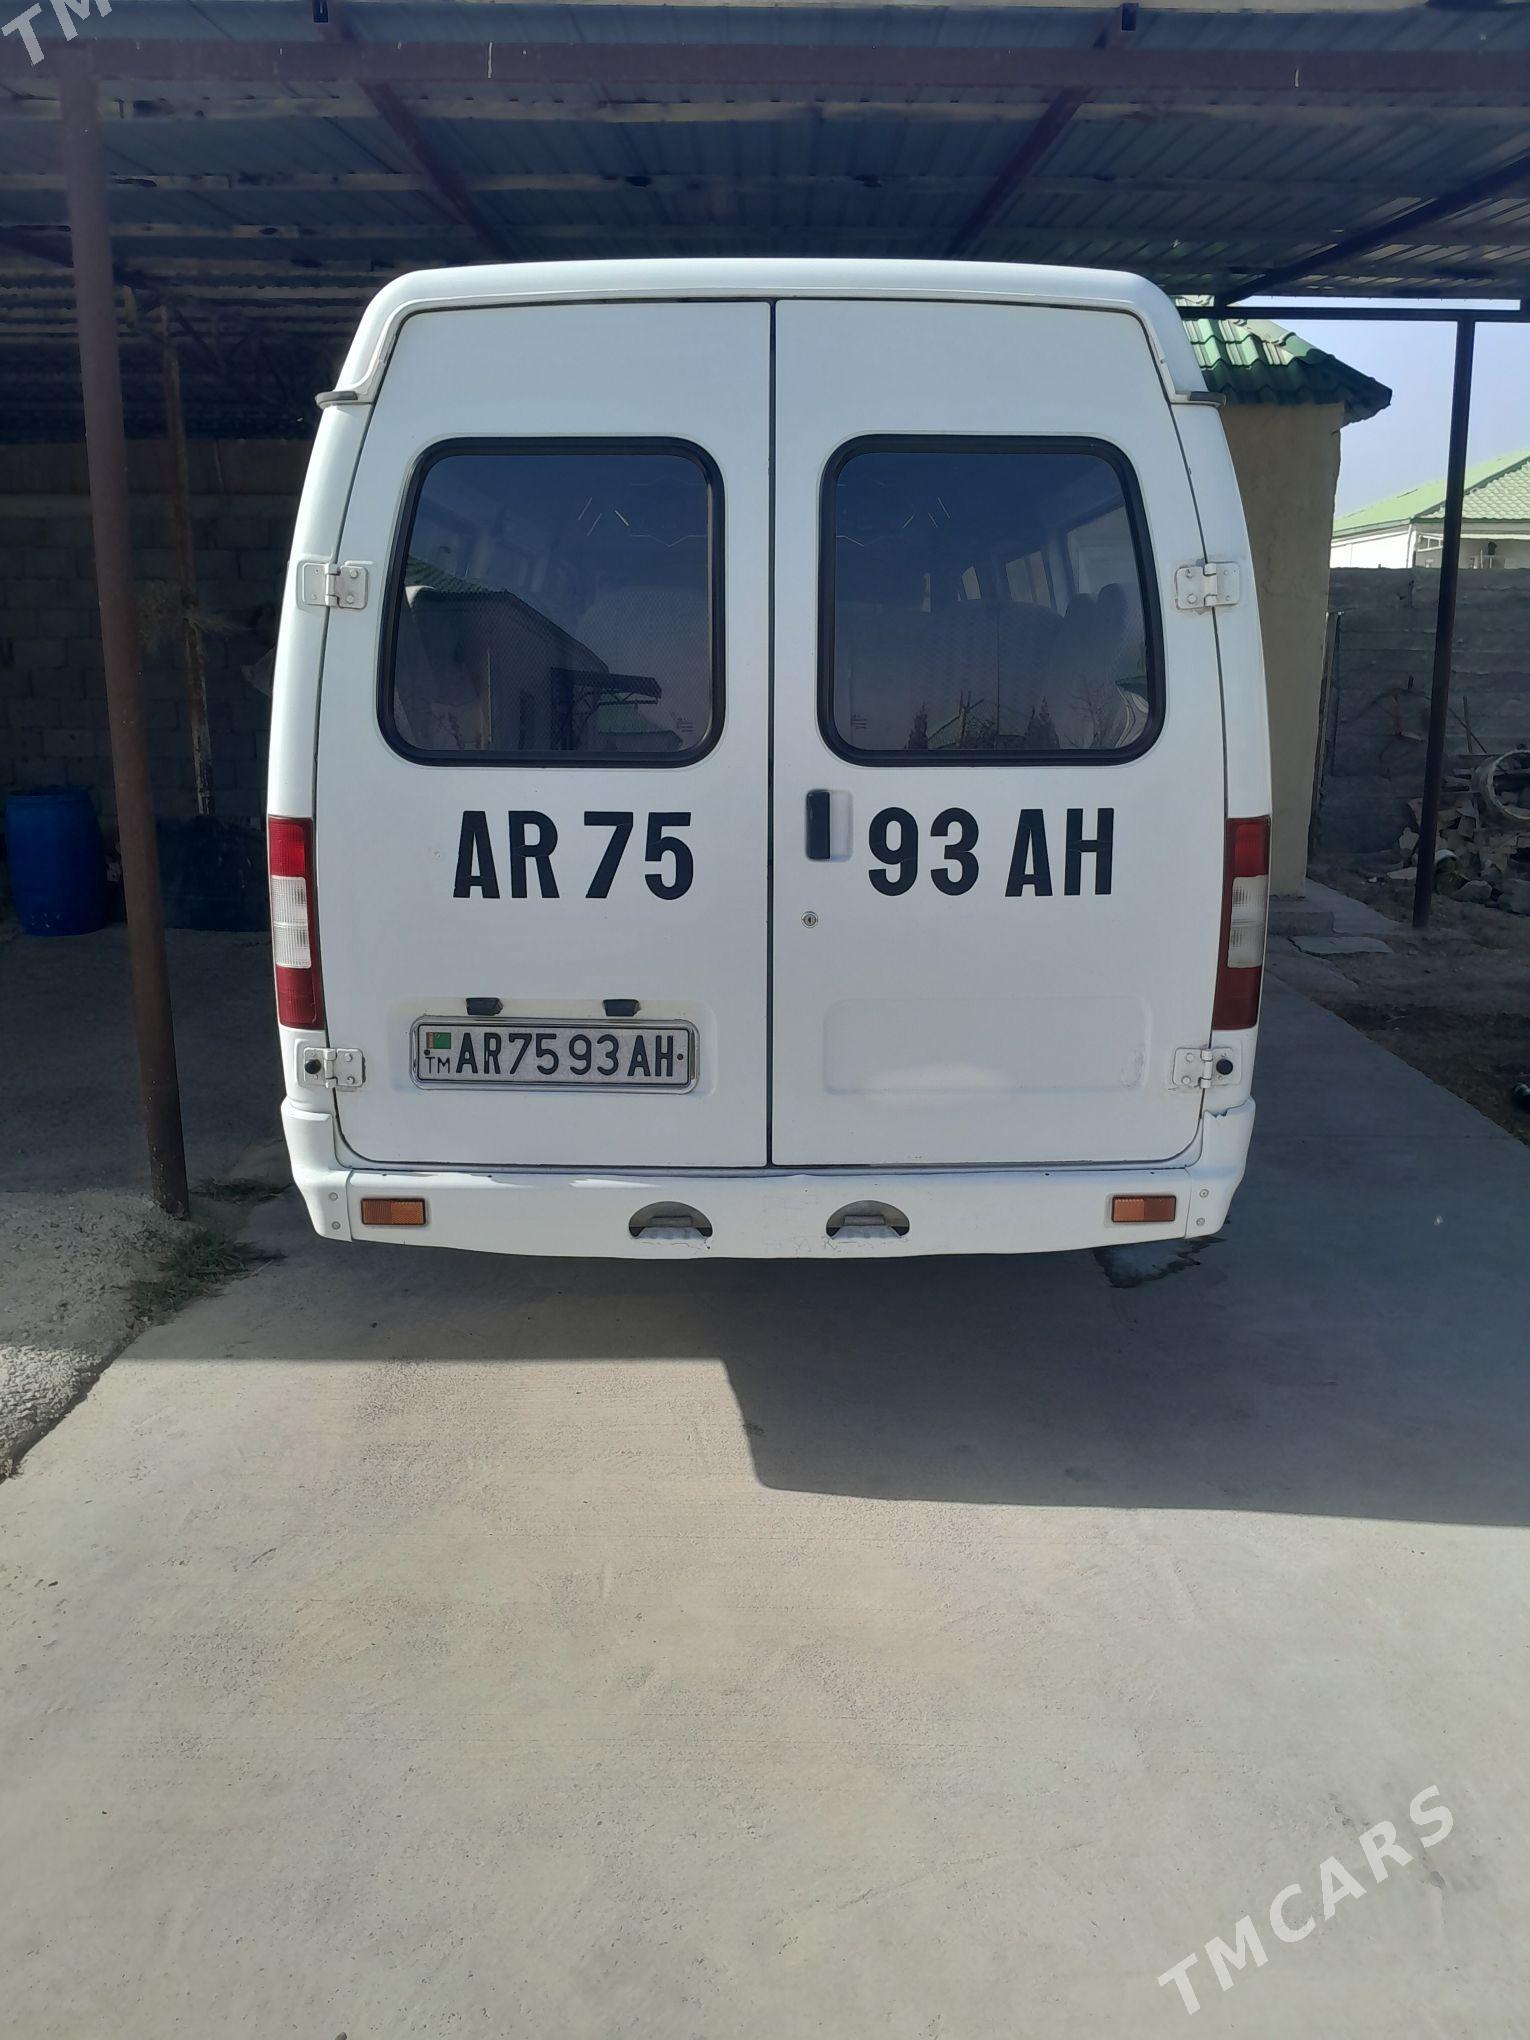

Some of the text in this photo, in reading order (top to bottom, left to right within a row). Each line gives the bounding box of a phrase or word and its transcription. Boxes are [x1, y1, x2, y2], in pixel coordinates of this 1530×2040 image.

[453, 810, 694, 900] AR 75
[868, 807, 1115, 897] 93 AH
[425, 1056, 450, 1075] TM
